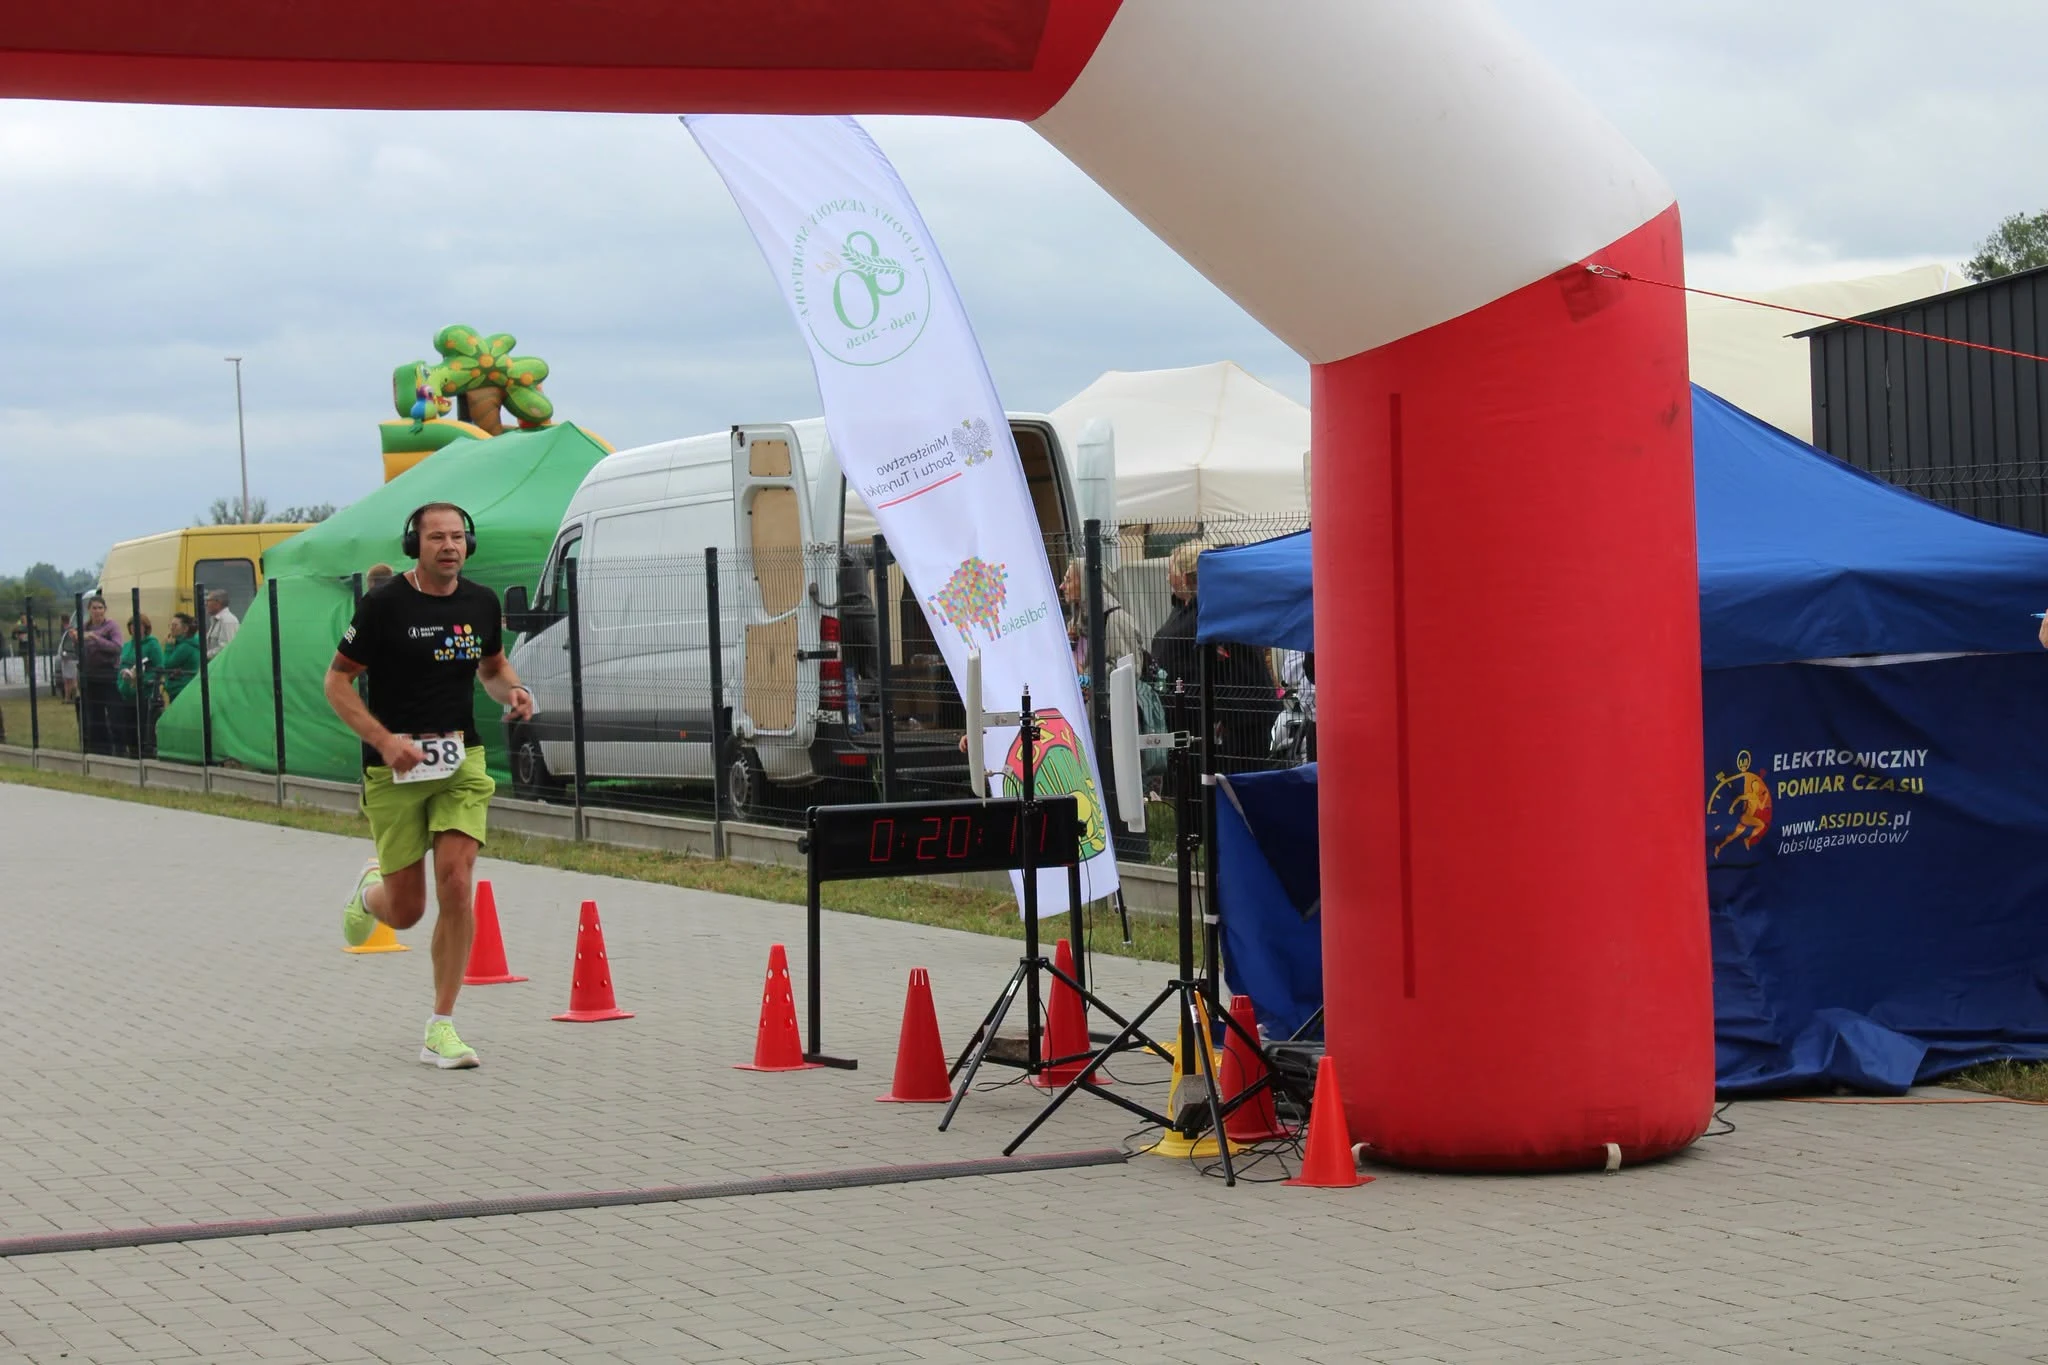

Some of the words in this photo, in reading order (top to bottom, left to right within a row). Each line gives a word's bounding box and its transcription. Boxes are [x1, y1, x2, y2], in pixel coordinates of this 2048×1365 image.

[421, 740, 460, 766] 58
[1773, 748, 1929, 773] ELEKTRONICZNY
[1776, 774, 1845, 800] POMIAR
[1851, 773, 1924, 795] CZASU
[1781, 810, 1912, 837] www.ASSIDUS.pl
[1777, 829, 1909, 856] /obslugazawodow/
